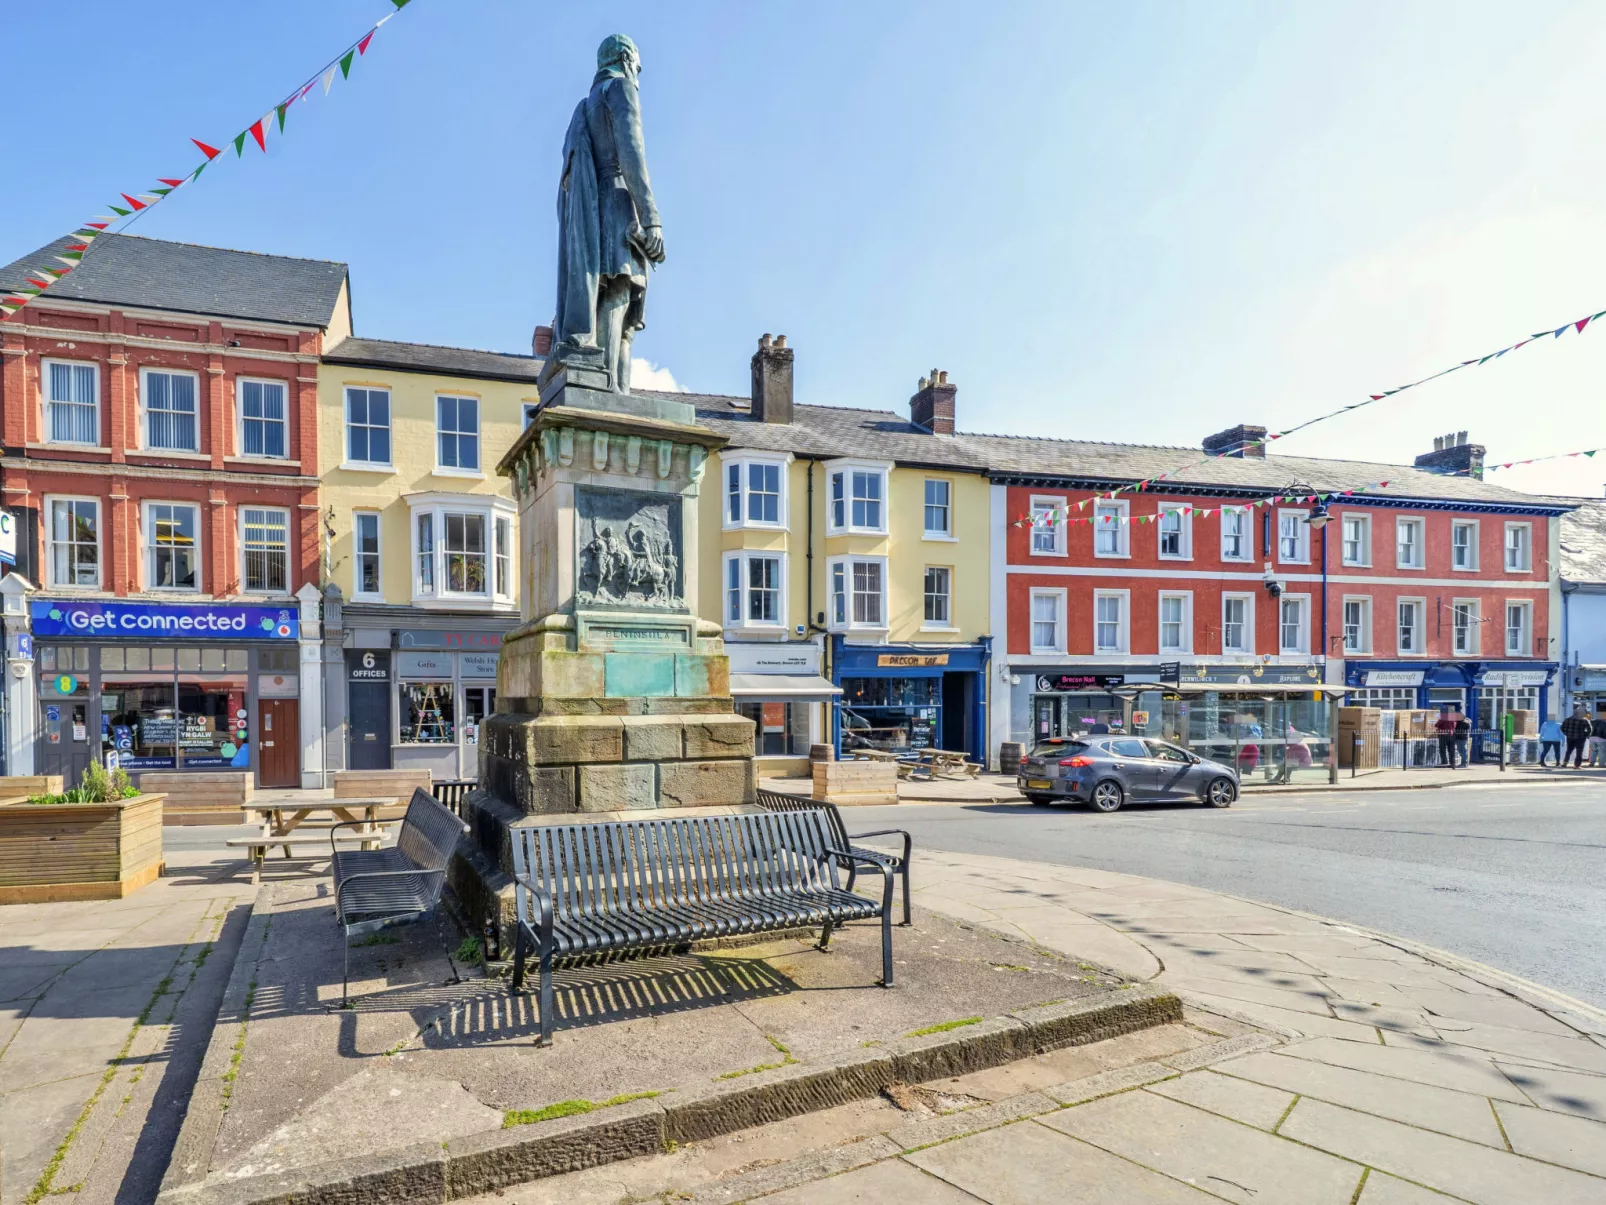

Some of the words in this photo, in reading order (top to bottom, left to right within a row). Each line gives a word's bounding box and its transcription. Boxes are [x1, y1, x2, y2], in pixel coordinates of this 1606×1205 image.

[71, 611, 116, 629] Get
[120, 613, 246, 631] connected
[605, 630, 670, 639] PENINSULA
[444, 633, 465, 646] TY
[469, 633, 504, 646] CAR
[362, 652, 376, 669] 6
[417, 660, 436, 668] Gifts
[477, 665, 494, 673] Store
[1375, 672, 1416, 681] Kitchencraft
